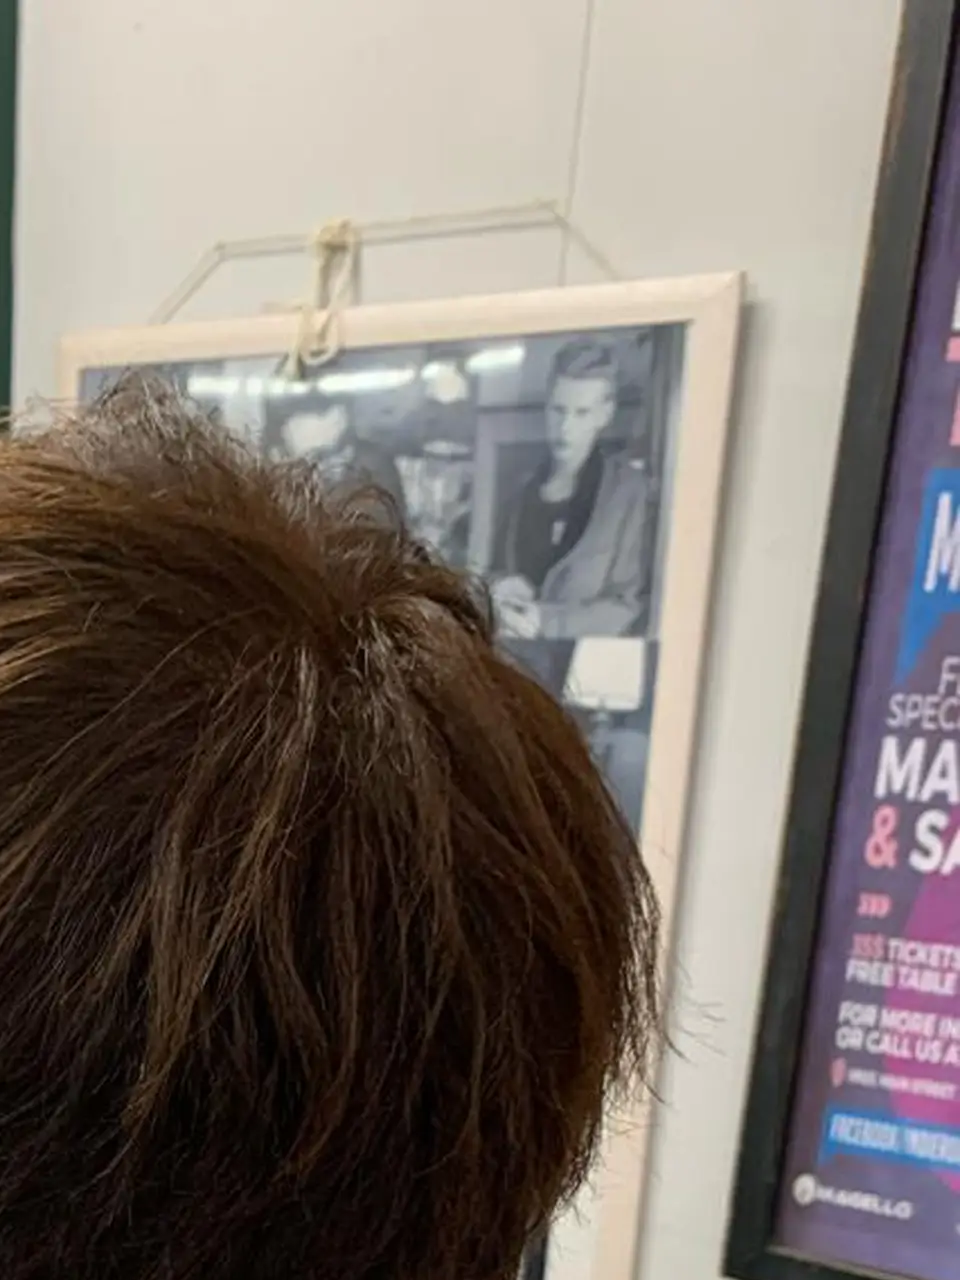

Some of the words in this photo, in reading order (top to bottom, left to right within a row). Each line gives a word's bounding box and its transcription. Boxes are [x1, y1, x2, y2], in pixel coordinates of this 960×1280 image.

[885, 693, 960, 731] SPEC
[864, 805, 899, 869] &
[845, 958, 895, 987] FREE
[897, 964, 957, 996] TABLE
[838, 1001, 879, 1028] FOR
[880, 1007, 938, 1037] MORE
[835, 1025, 864, 1051] OR
[865, 1030, 913, 1058] CALL
[914, 1039, 943, 1063] US
